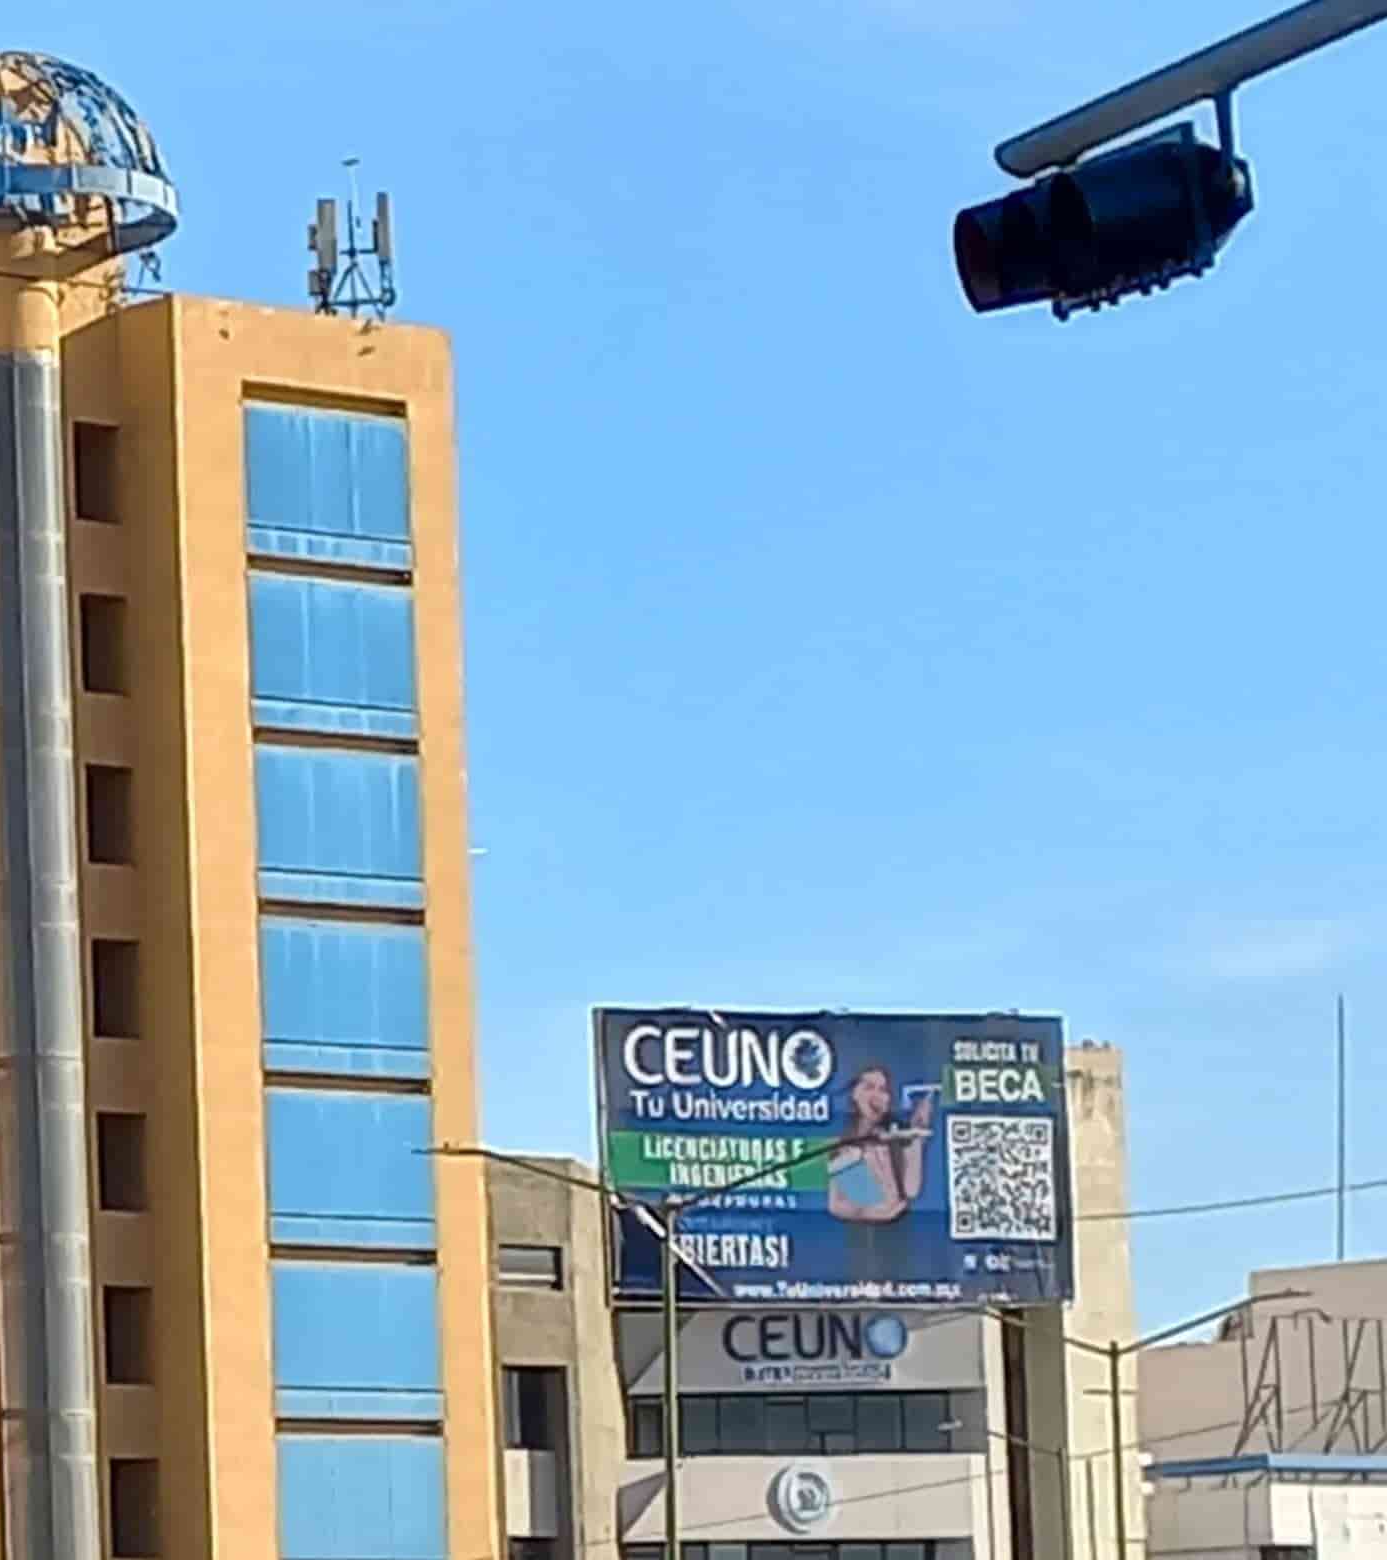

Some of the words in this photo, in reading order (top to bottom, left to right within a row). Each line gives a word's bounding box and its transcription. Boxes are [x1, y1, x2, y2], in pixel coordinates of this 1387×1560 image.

[624, 1024, 832, 1089] CEUNO
[955, 1069, 1044, 1101] BECA
[629, 1090, 664, 1118] Tu
[672, 1090, 830, 1121] Universidad
[723, 1313, 908, 1362] CEUNO
